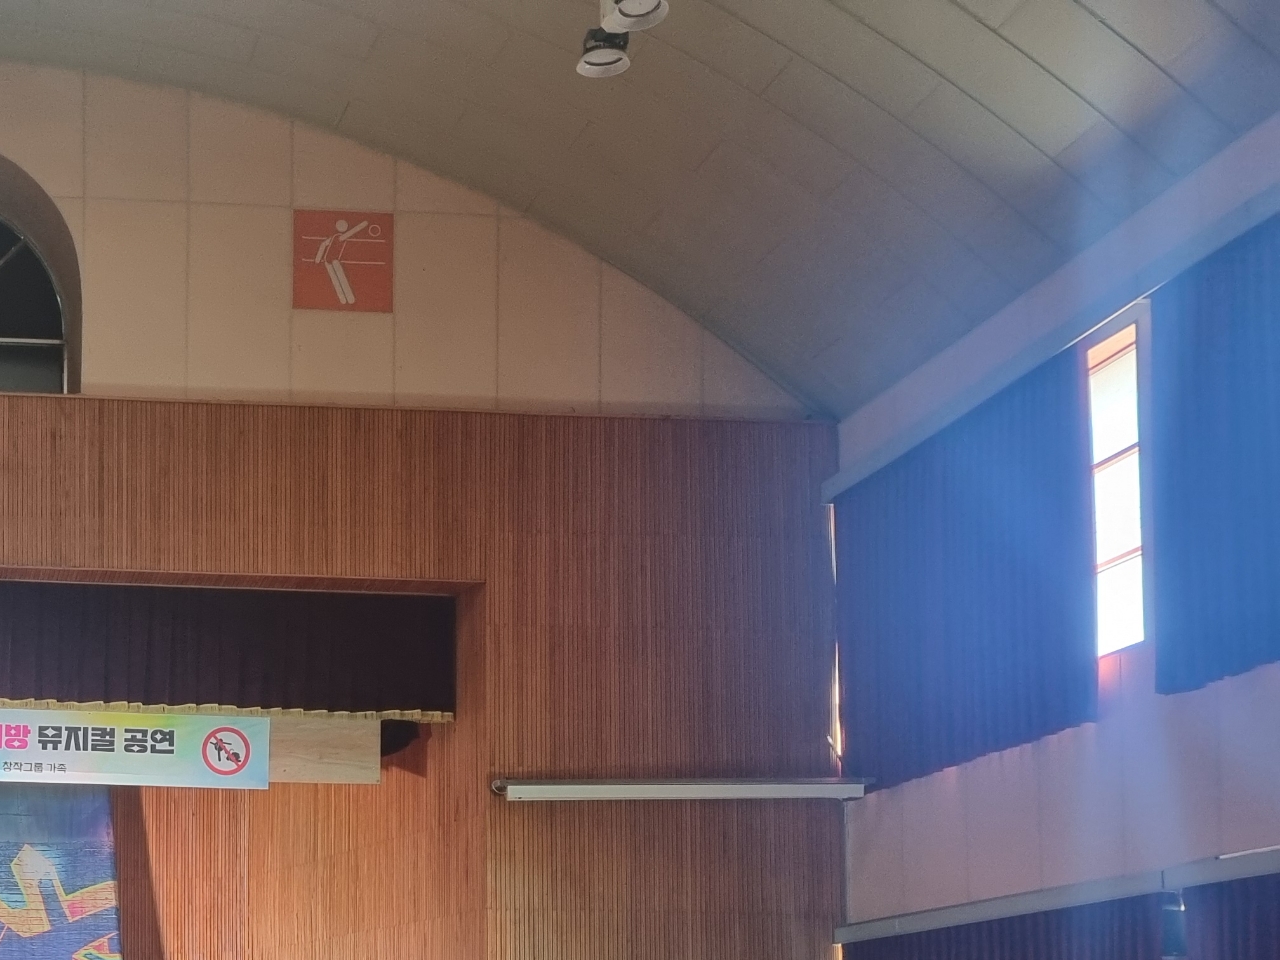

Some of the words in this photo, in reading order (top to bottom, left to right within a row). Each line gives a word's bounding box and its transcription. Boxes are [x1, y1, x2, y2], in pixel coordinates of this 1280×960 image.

[37, 725, 116, 753] 뮤지컬
[122, 728, 175, 755] 공연
[2, 761, 43, 773] 창작그룹
[47, 763, 67, 774] 가족
